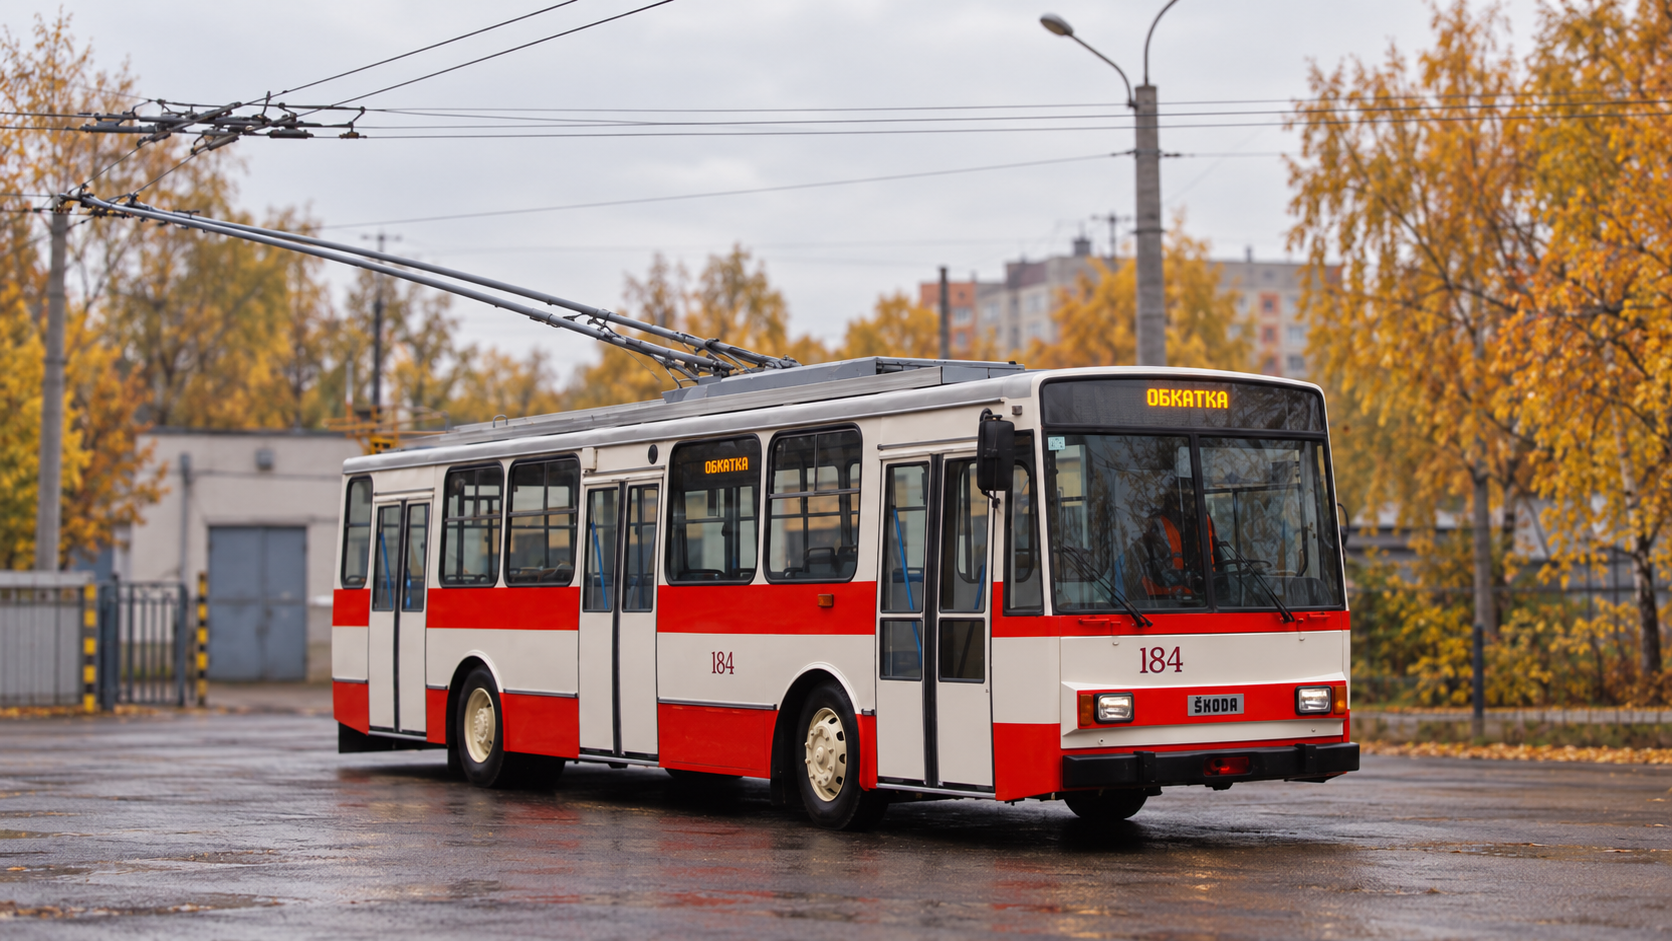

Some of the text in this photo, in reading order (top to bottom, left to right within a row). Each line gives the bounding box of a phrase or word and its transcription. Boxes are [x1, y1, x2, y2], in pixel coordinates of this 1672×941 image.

[1147, 388, 1228, 408] ОБКАТКА
[705, 457, 748, 474] ОБКАТКА
[711, 651, 734, 674] 184
[1139, 646, 1183, 673] 184
[1194, 697, 1237, 713] ŠKODA
